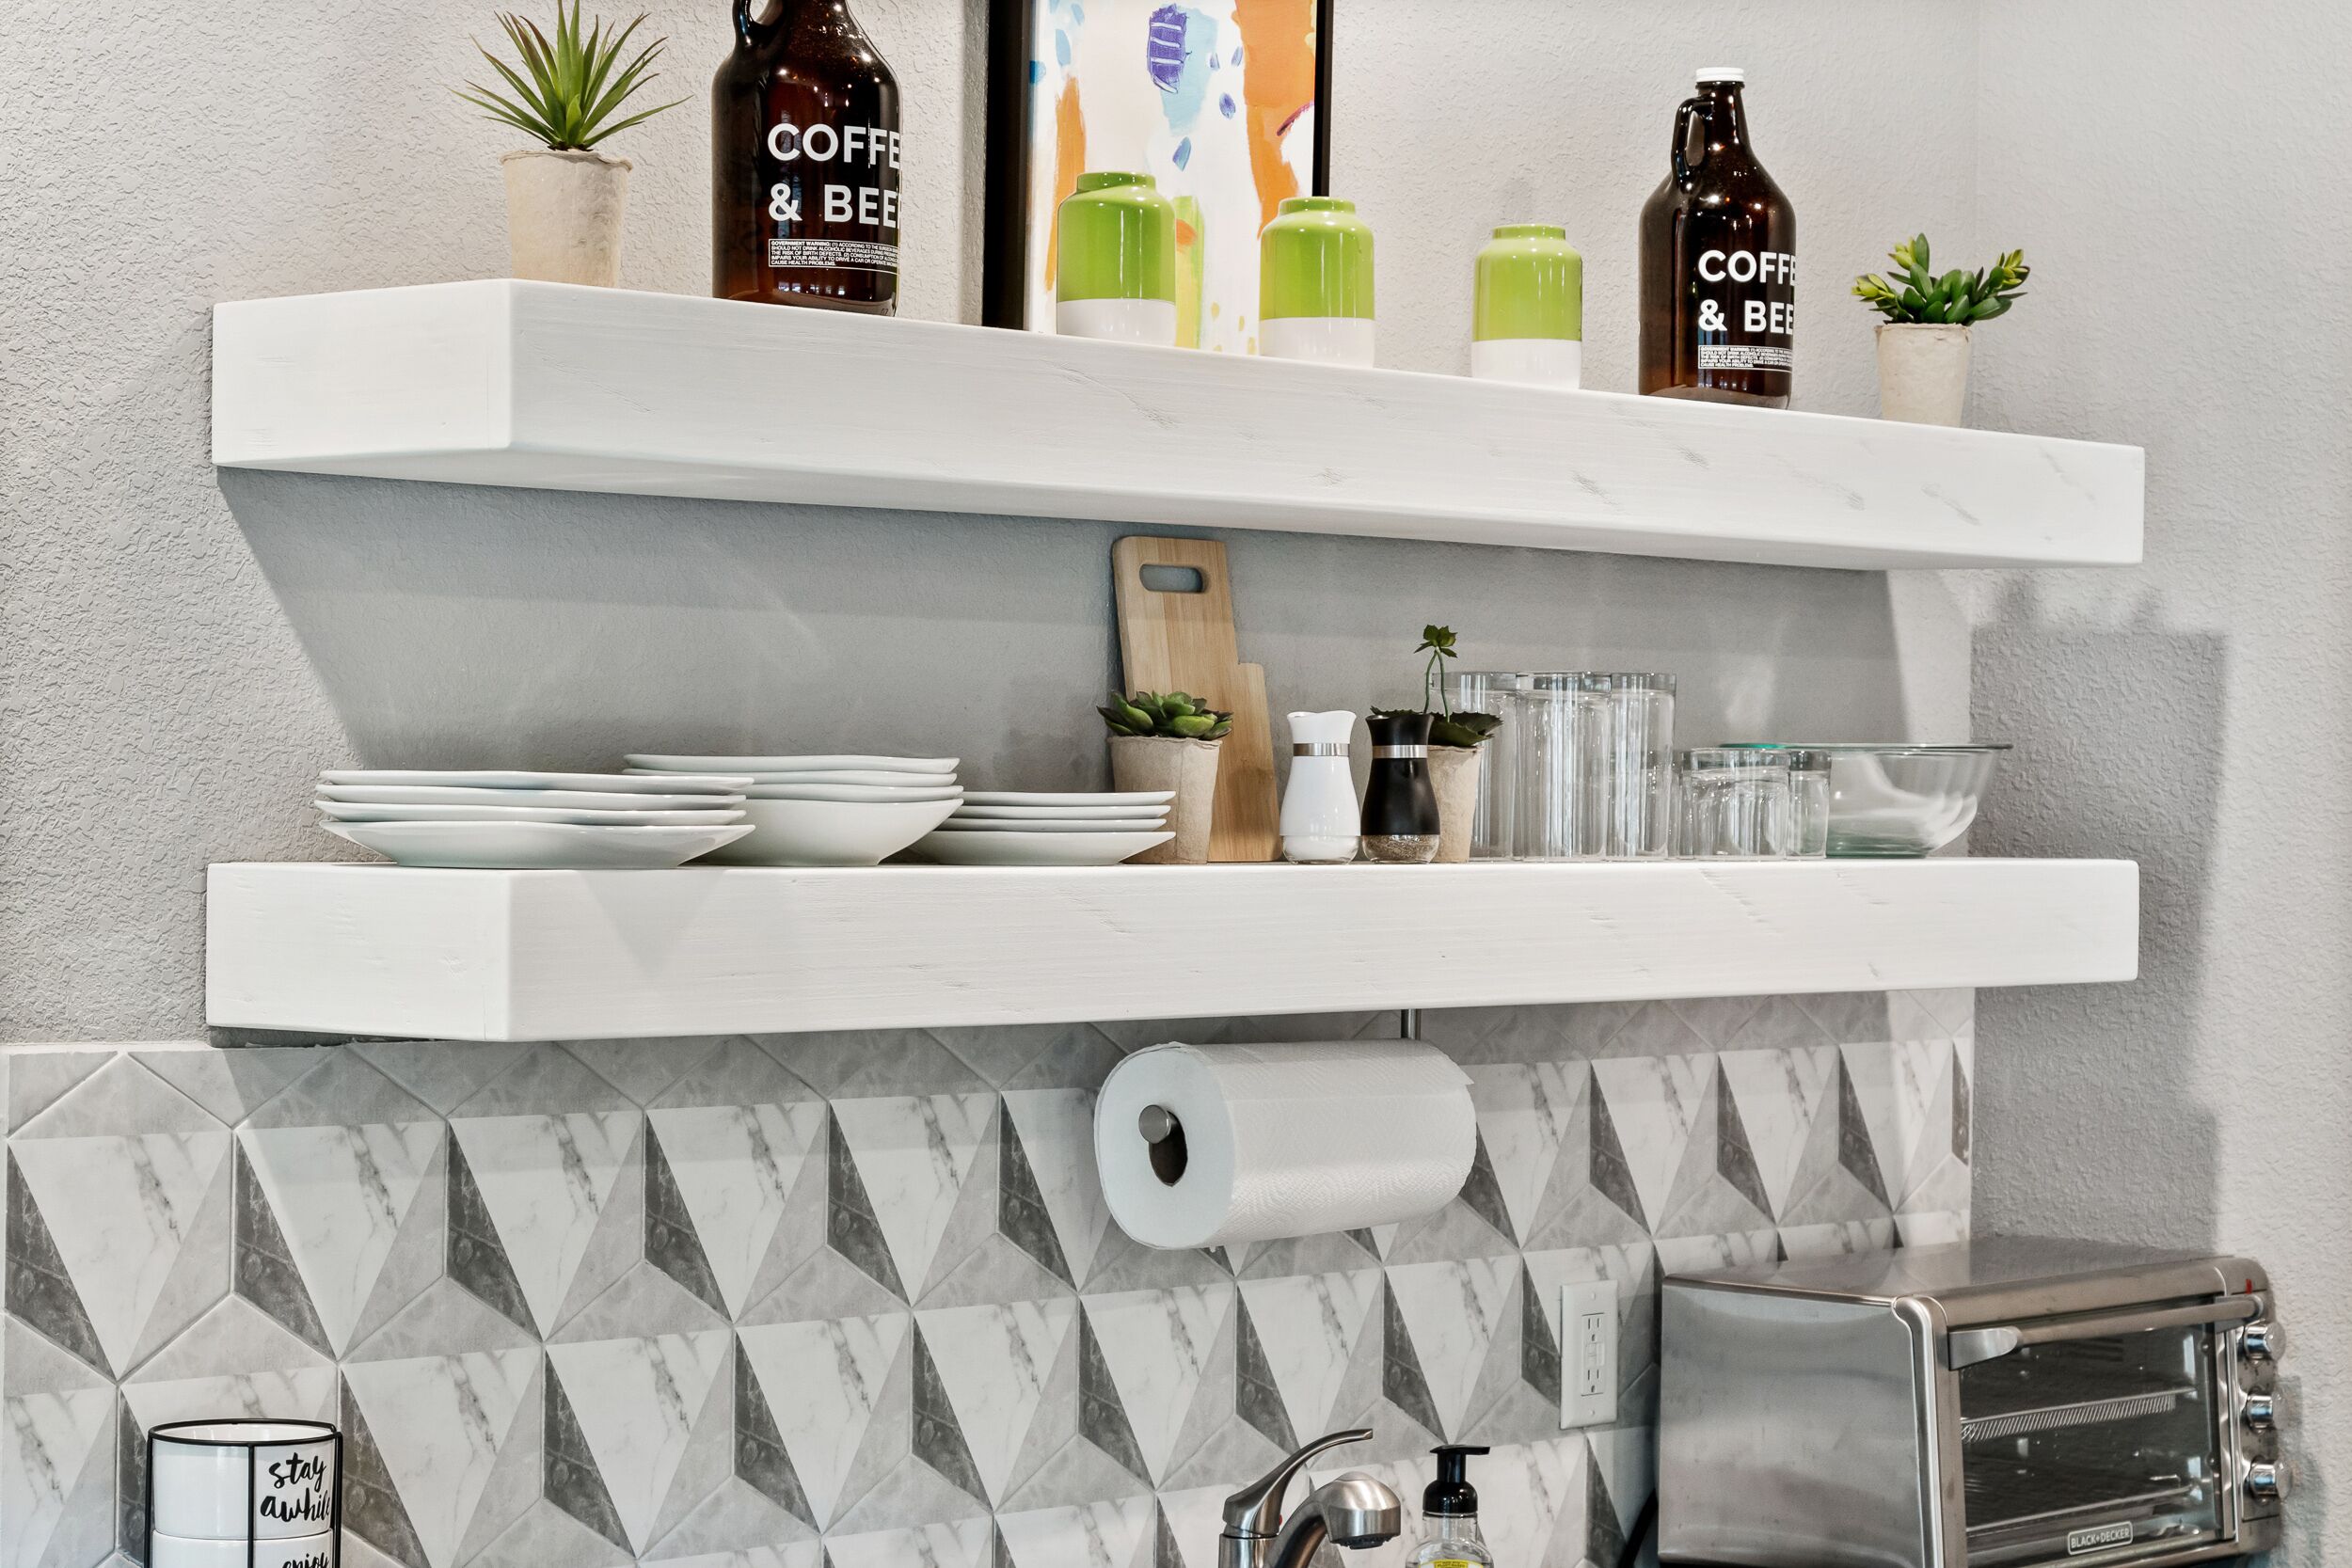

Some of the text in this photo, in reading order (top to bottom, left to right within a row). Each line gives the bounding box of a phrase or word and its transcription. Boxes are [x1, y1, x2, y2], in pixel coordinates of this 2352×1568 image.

[769, 183, 899, 229] & BEE
[1698, 299, 1727, 331] &
[269, 1452, 326, 1493] stay
